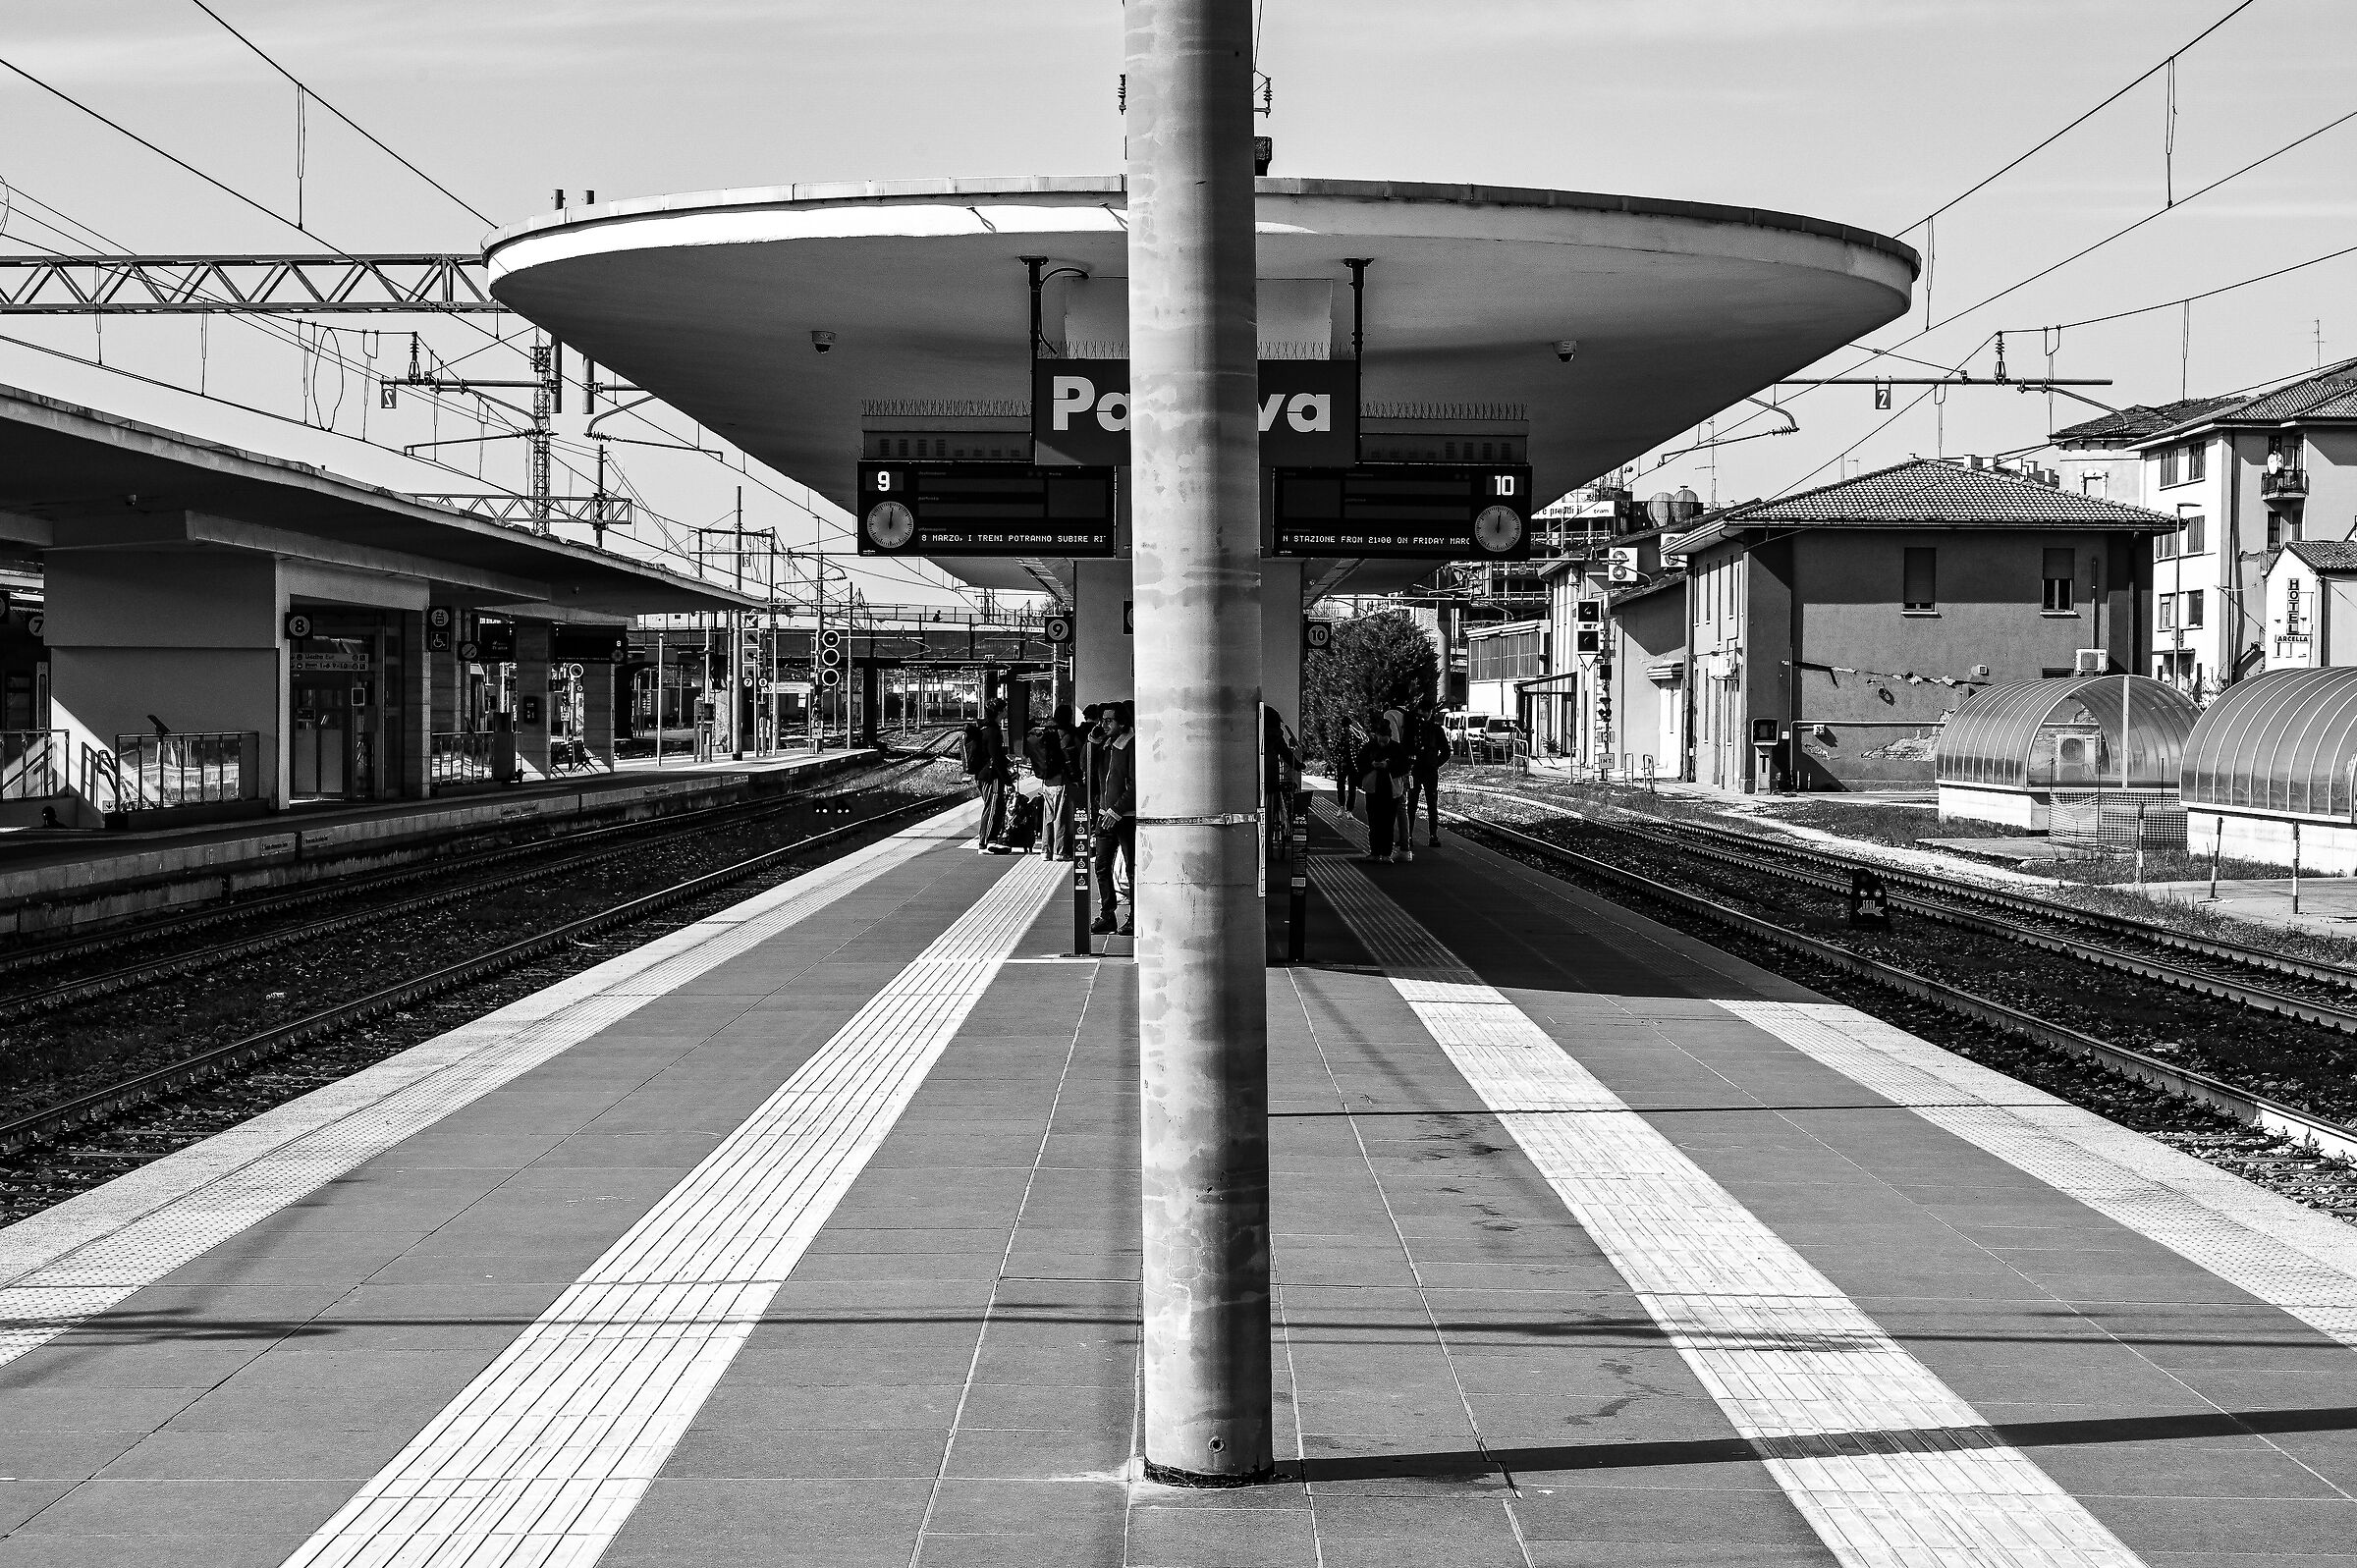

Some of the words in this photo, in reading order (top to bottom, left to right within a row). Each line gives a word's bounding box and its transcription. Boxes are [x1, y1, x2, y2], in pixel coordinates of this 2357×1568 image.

[1053, 375, 1331, 432] Pava
[1879, 390, 1888, 408] 2
[877, 470, 891, 491] 9
[1494, 475, 1514, 496] 10
[1008, 534, 1053, 543] POTRANNO
[1341, 535, 1363, 544] FROM
[1412, 536, 1445, 545] FRIDAY
[2288, 579, 2299, 633] HOTEL
[33, 619, 45, 633] 7
[295, 619, 305, 633] 8
[1052, 622, 1064, 636] 9
[1311, 629, 1326, 641] 10
